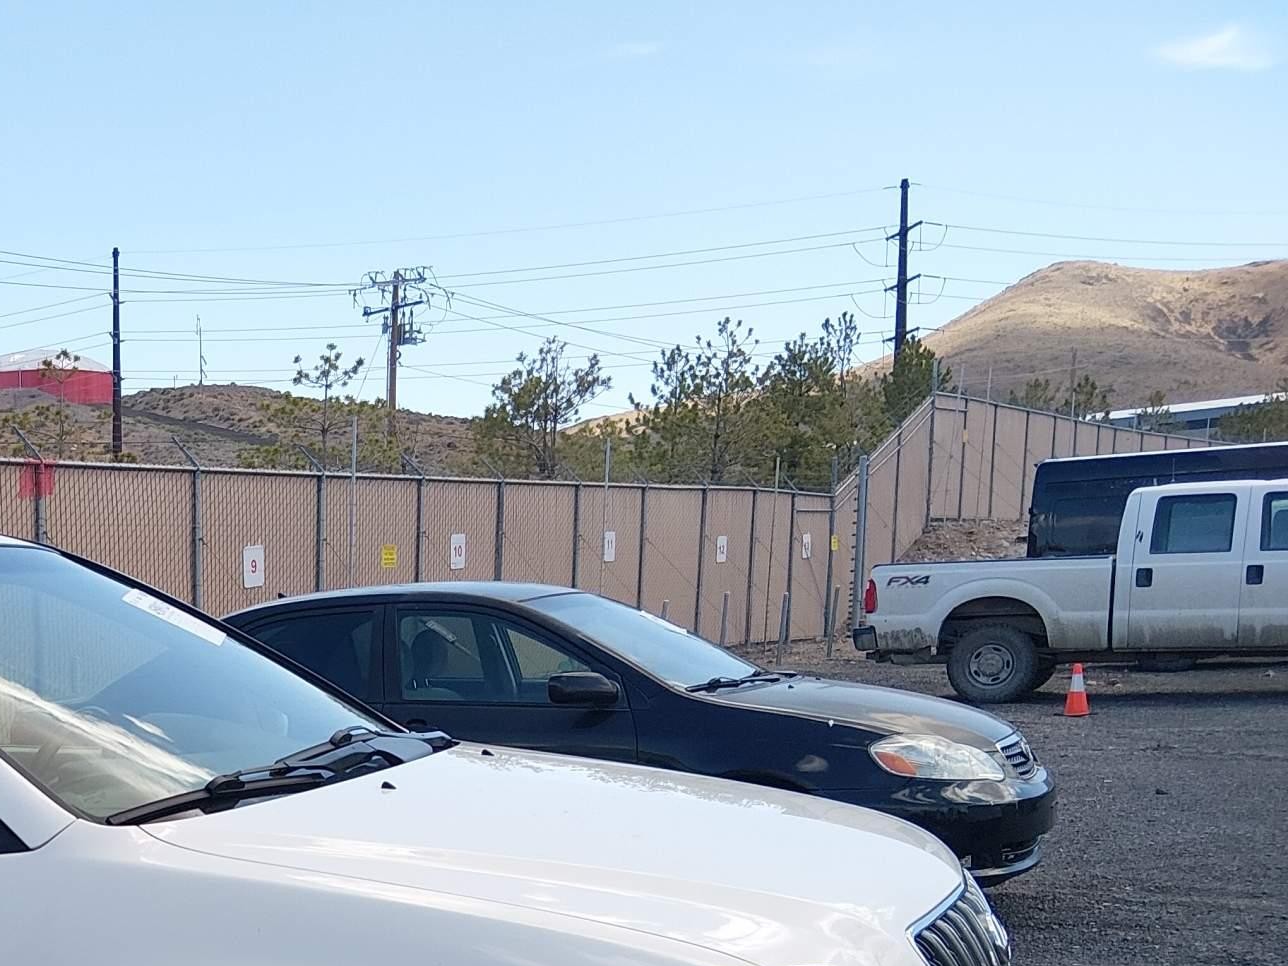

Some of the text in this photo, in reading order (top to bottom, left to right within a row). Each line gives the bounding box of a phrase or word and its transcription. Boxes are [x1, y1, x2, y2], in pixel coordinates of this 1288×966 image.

[453, 545, 463, 558] 10
[250, 559, 257, 574] 9
[886, 575, 931, 587] FX4
